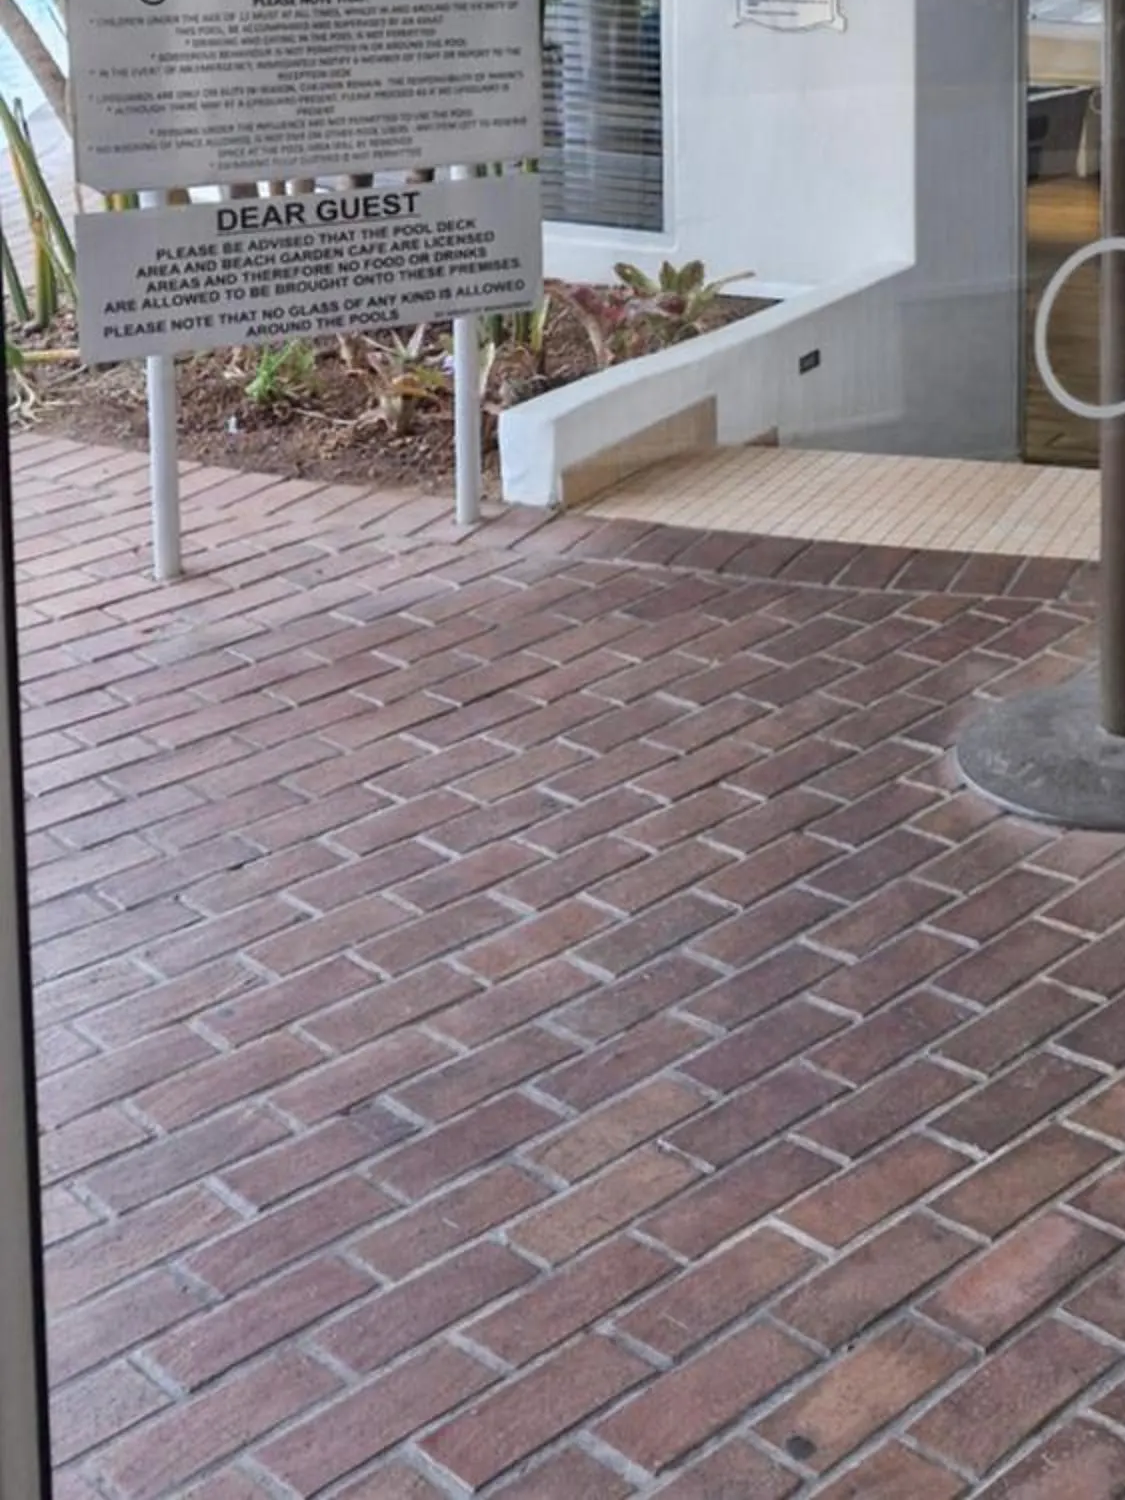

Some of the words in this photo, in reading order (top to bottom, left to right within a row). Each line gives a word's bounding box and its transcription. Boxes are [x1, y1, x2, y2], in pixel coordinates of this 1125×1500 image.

[217, 203, 305, 231] DEAR
[316, 192, 420, 221] GUEST
[137, 262, 180, 277] AREA
[184, 259, 216, 273] AND
[220, 253, 276, 269] BEACH
[280, 246, 343, 264] GARDEN
[347, 242, 386, 257] CAFE
[390, 239, 420, 253] ARE
[424, 232, 494, 249] LICENSED
[157, 242, 218, 259] PLEASE
[222, 240, 244, 253] BE
[248, 233, 314, 250] ADVISED
[318, 229, 355, 244] THAT
[359, 226, 388, 240] THE
[392, 222, 431, 237] POOL
[435, 218, 474, 233] DECK
[105, 299, 137, 313] ARE
[141, 290, 220, 309] ALLOWED
[224, 287, 245, 301] TO
[249, 285, 270, 298] BE
[274, 277, 348, 295] BROUGHT
[352, 272, 394, 287] ONTO
[398, 267, 444, 282] THESE
[147, 276, 200, 292] AREAS
[204, 272, 238, 286] AND
[242, 263, 333, 283] THEREFORE
[337, 260, 359, 273] NO
[363, 256, 404, 271] FOOD
[408, 253, 429, 266] OR
[433, 248, 486, 264] DRINKS
[104, 320, 166, 337] PLEASE
[170, 314, 214, 330] NOTE
[218, 310, 257, 325] THAT
[261, 307, 284, 320] NO
[288, 301, 339, 317] GLASS
[343, 298, 362, 311] OF
[366, 295, 396, 309] ANY
[400, 290, 434, 305] KIND
[438, 289, 452, 301] IS
[456, 281, 524, 299] ALLOWED
[247, 320, 312, 337] AROUND
[316, 316, 344, 330] THE
[348, 311, 398, 327] POOLS
